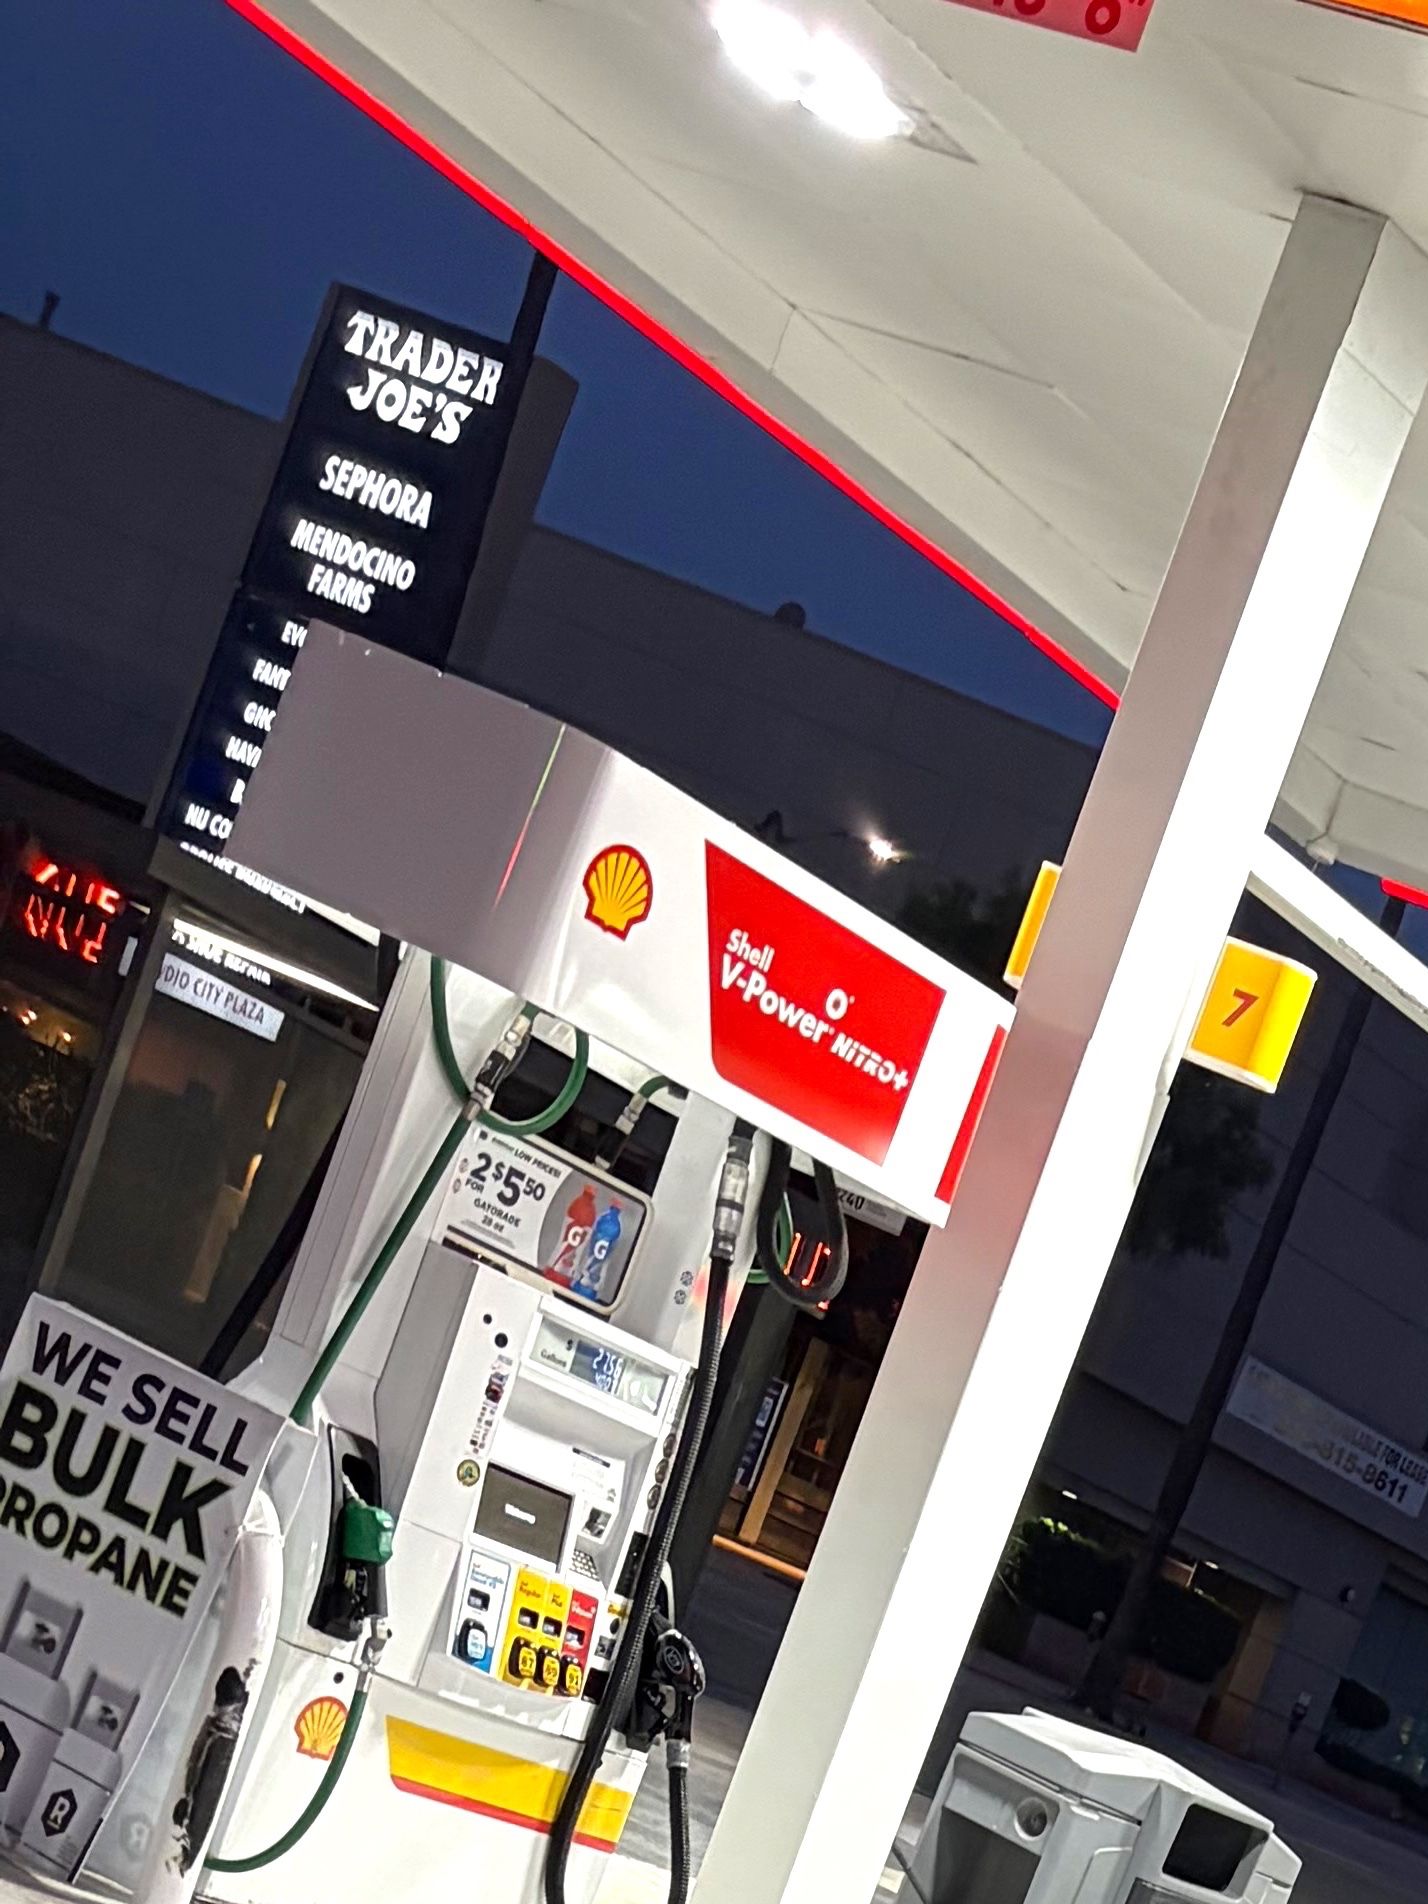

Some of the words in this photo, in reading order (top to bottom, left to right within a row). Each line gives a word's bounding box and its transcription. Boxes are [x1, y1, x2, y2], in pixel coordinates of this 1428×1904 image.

[344, 311, 503, 405] TRADER
[347, 367, 472, 445] JOE'S
[319, 455, 433, 530] SEPHORA
[291, 519, 416, 591] MENDOCINO
[307, 562, 375, 614] FARMS
[184, 803, 209, 830] NU
[726, 928, 775, 972] Shell
[161, 963, 190, 989] DIO
[193, 977, 223, 1005] CITY
[223, 991, 265, 1025] PLAZA
[721, 953, 829, 1044] V-Power
[1221, 988, 1259, 1027] 7
[465, 1178, 485, 1194] FOR
[470, 1152, 492, 1183] 2
[474, 1197, 522, 1228] GATORADE
[568, 1226, 583, 1246] G
[593, 1240, 609, 1260] G
[31, 1321, 122, 1406] WE
[121, 1373, 250, 1477] SELL
[0, 1380, 235, 1562] BULK
